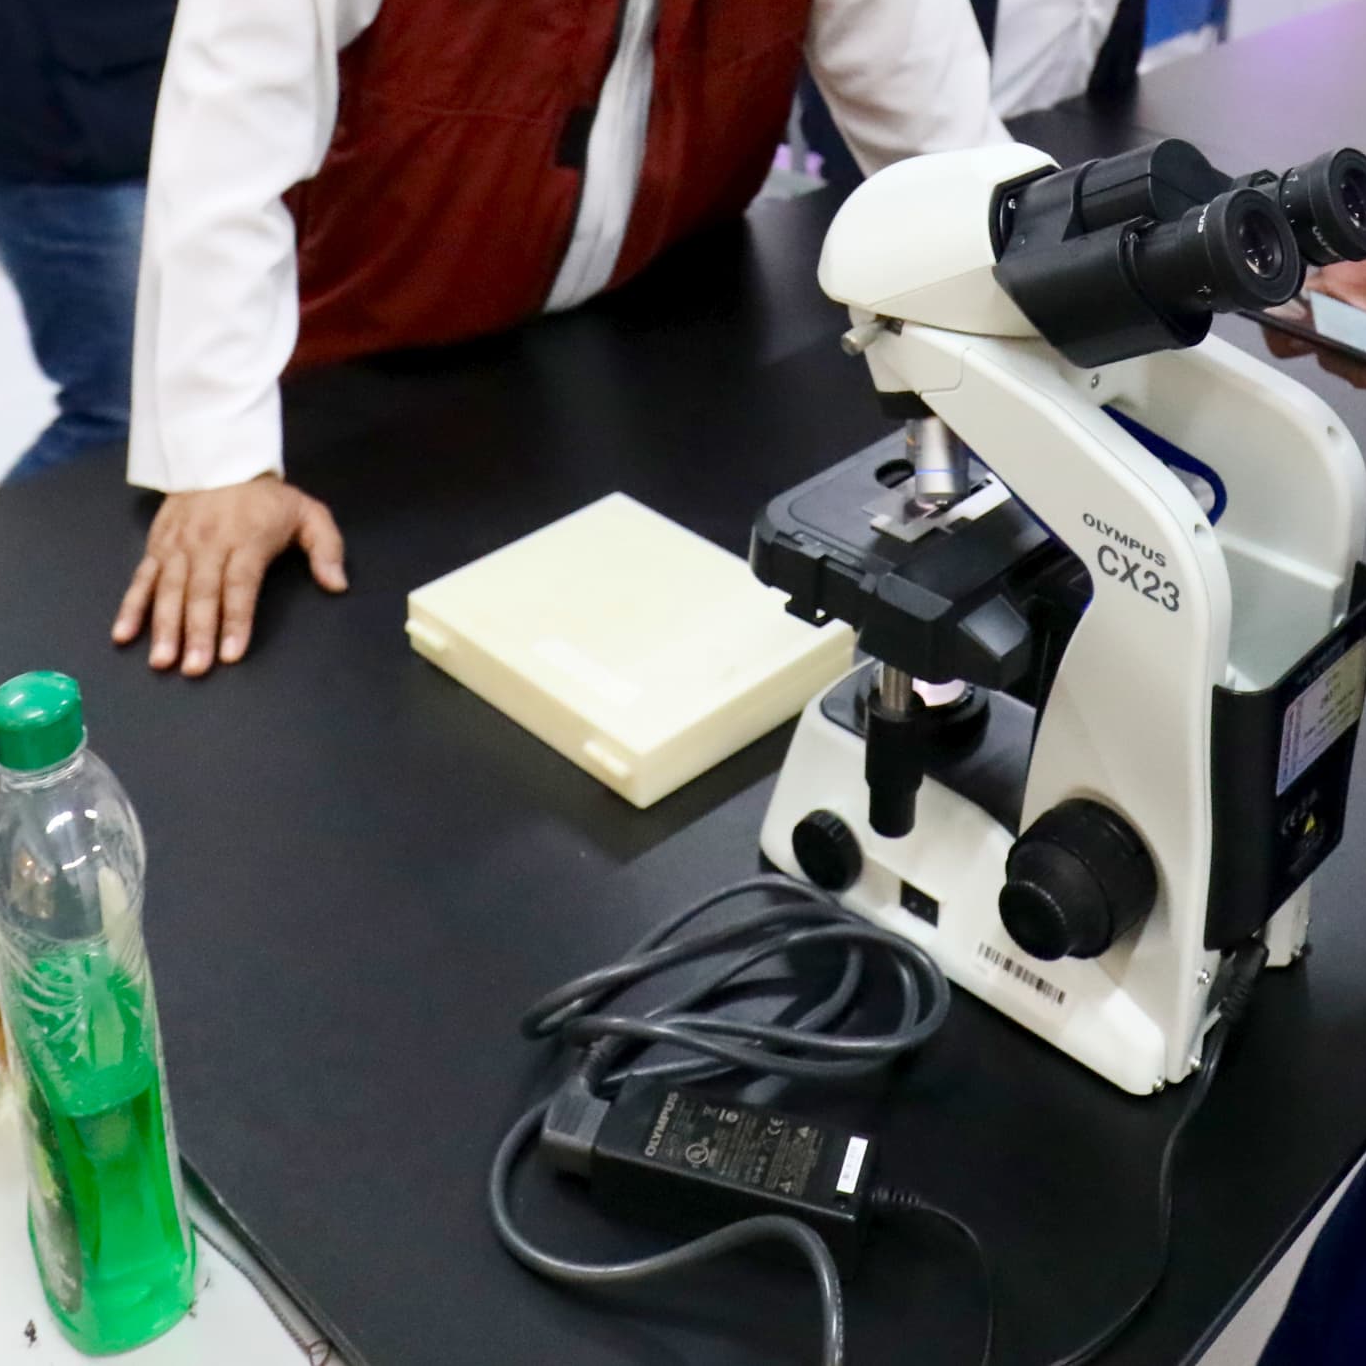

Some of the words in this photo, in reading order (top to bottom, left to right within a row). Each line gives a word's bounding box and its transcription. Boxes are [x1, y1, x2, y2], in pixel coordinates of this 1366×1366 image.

[1082, 512, 1166, 568] OLYMPUS
[1097, 544, 1180, 612] CX23
[644, 1090, 679, 1157] OLYMPUS
